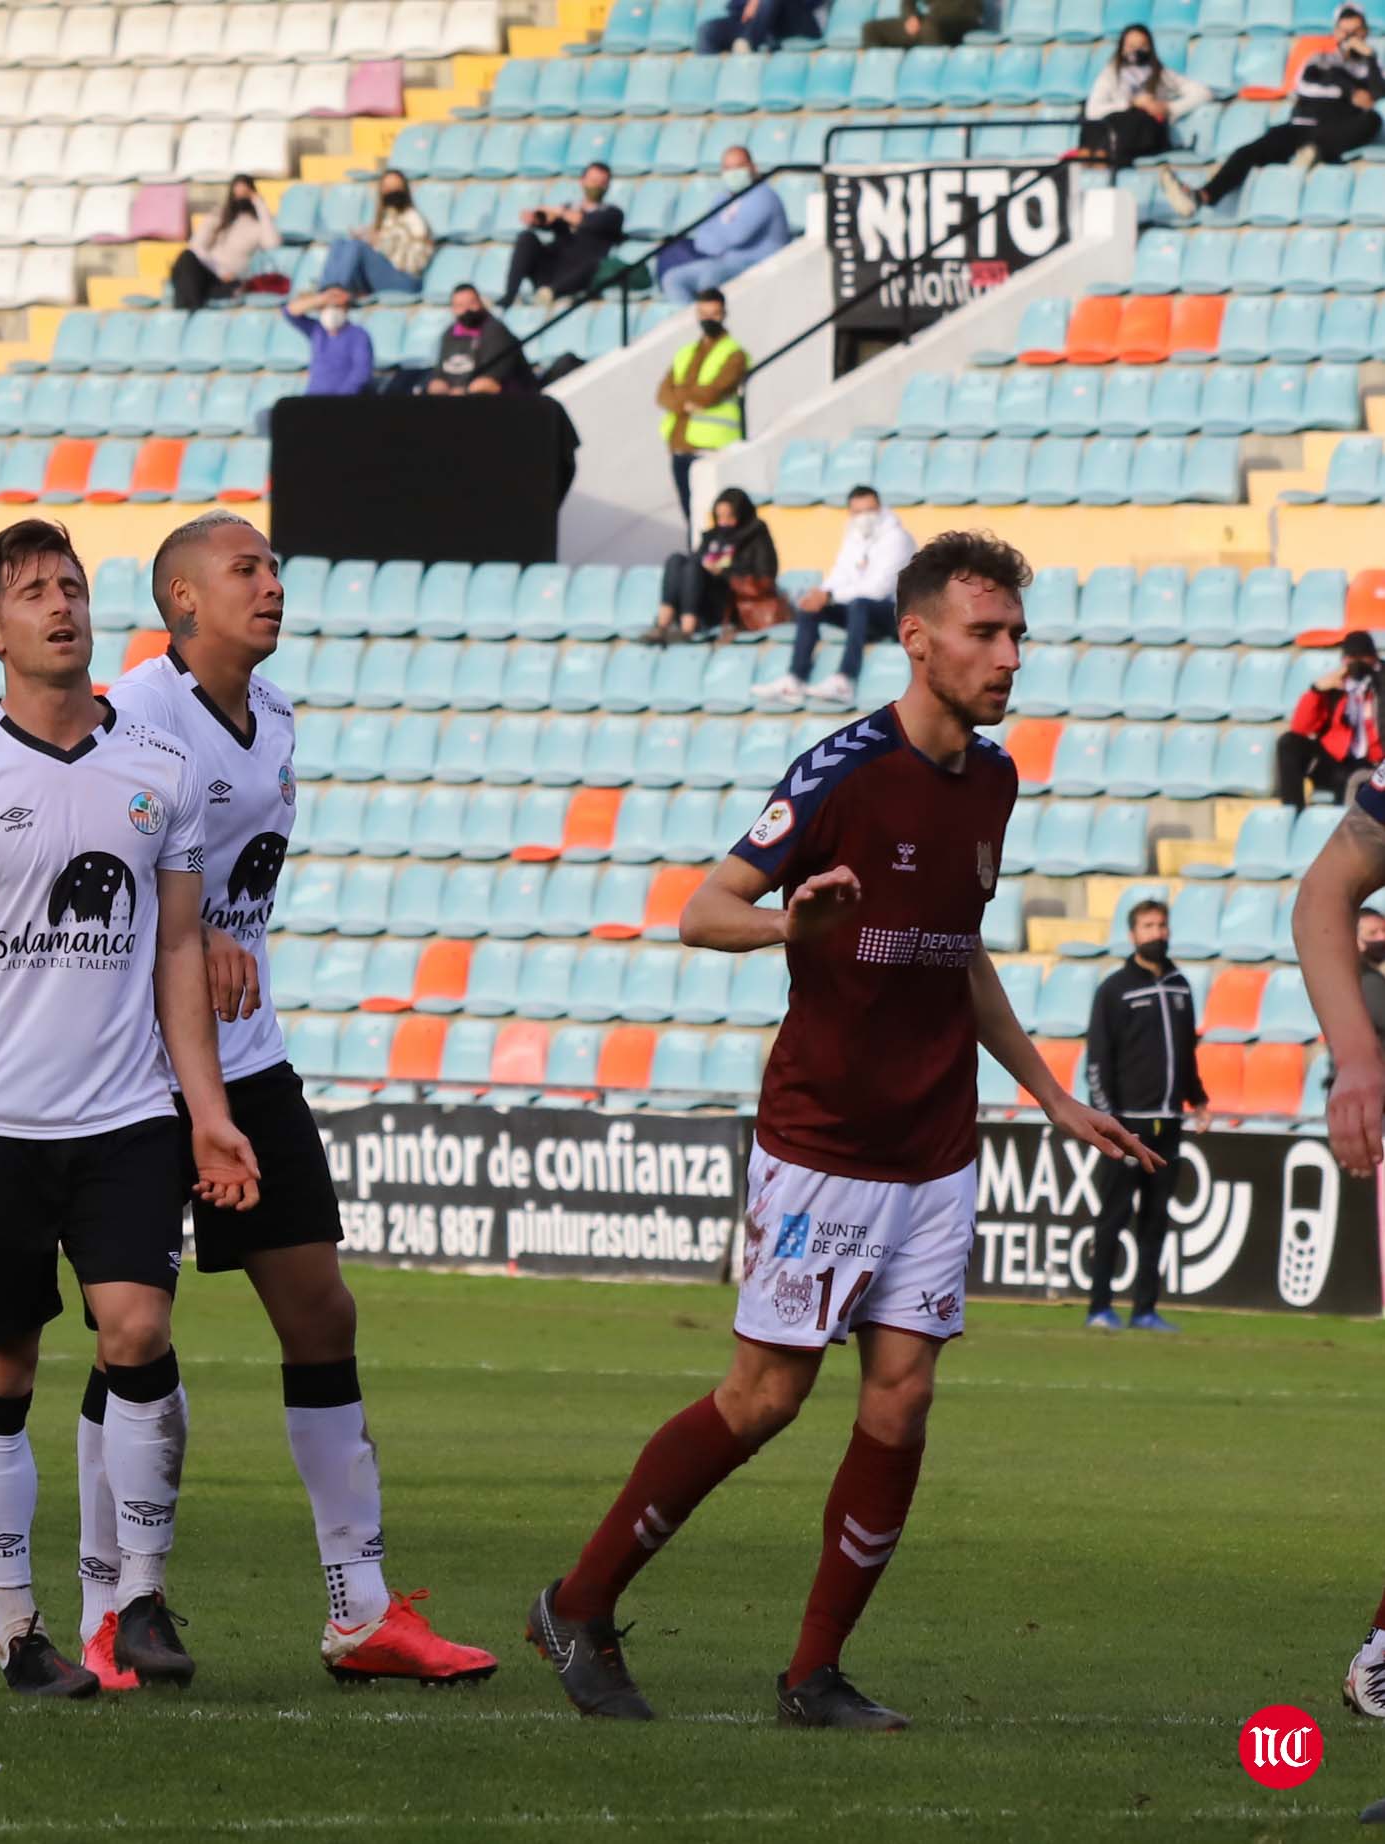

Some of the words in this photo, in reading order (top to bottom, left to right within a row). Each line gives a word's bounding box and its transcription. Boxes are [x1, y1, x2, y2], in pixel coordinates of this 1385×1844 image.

[856, 168, 1061, 262] NIETO
[4, 820, 34, 833] umbro
[356, 1112, 485, 1200] pintor
[487, 1130, 532, 1190] de
[534, 1120, 734, 1198] confianza
[387, 1201, 438, 1257] 246
[440, 1204, 496, 1258] 887
[507, 1199, 733, 1263] pinturasoche.es
[815, 1220, 868, 1241] XUNTA
[811, 1239, 831, 1255] DE
[120, 1510, 174, 1528] umbro
